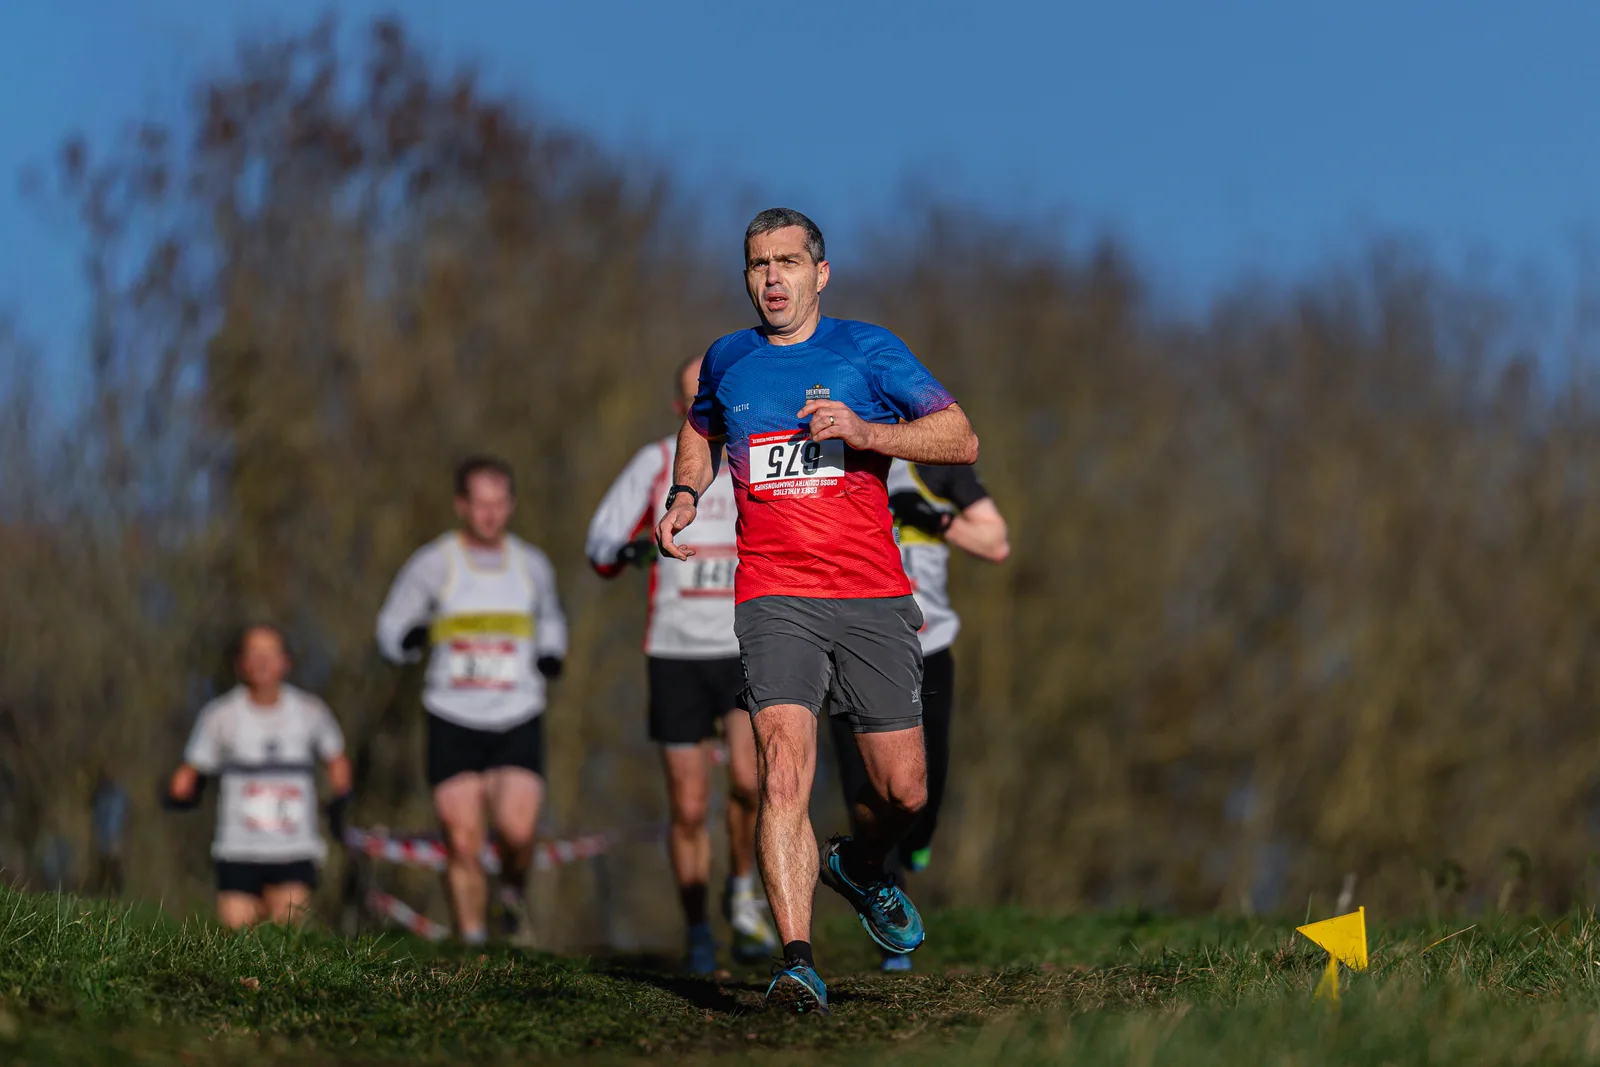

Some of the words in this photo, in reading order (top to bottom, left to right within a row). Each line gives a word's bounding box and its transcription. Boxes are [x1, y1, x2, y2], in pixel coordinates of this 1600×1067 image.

[733, 403, 750, 413] TACTIC
[766, 441, 821, 478] 675
[754, 480, 795, 491] CHAMPIONSHIPS
[795, 479, 820, 487] COUNTRY
[820, 478, 838, 486] CROSS
[773, 487, 800, 496] ATHLETICS
[800, 486, 818, 494] ESSEX
